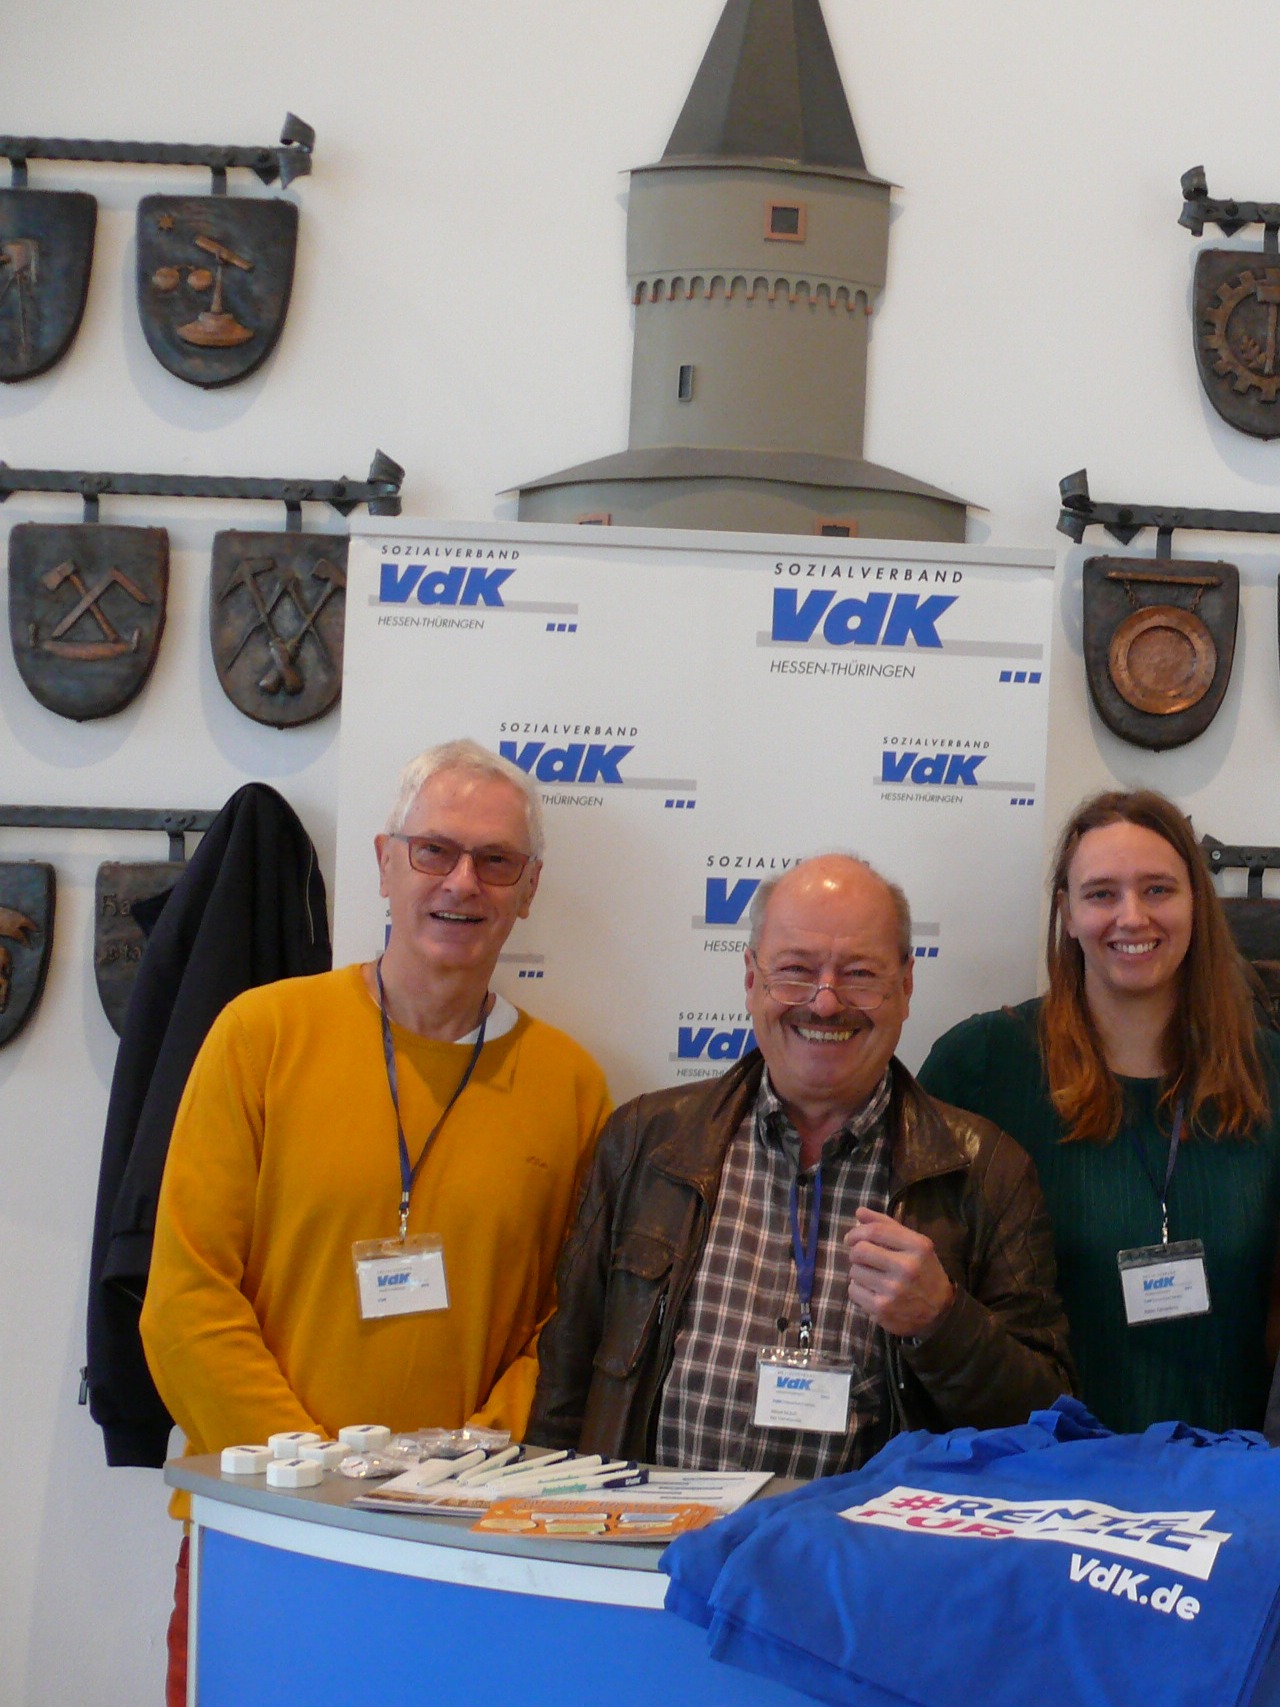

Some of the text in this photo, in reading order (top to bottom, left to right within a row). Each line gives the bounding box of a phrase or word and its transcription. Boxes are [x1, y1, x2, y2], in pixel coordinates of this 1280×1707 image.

[381, 545, 520, 560] SOZIALVERBAND
[774, 562, 963, 583] SOZIALVERBAND
[379, 563, 517, 607] VdK
[377, 615, 485, 630] HESSEN-THÜRINGEN
[771, 587, 959, 648] VdK
[770, 659, 916, 679] HESSEN-THÜRINGEN
[500, 722, 639, 737] SOZIALVERBAND
[883, 736, 990, 749] SOZIALVERBAND
[500, 740, 635, 784] VdK
[882, 751, 987, 786] VdK
[881, 792, 964, 804] HESSEN-THÜRINGEN
[889, 1495, 1190, 1529] #RENTE
[1069, 1553, 1201, 1621] VdK.de
